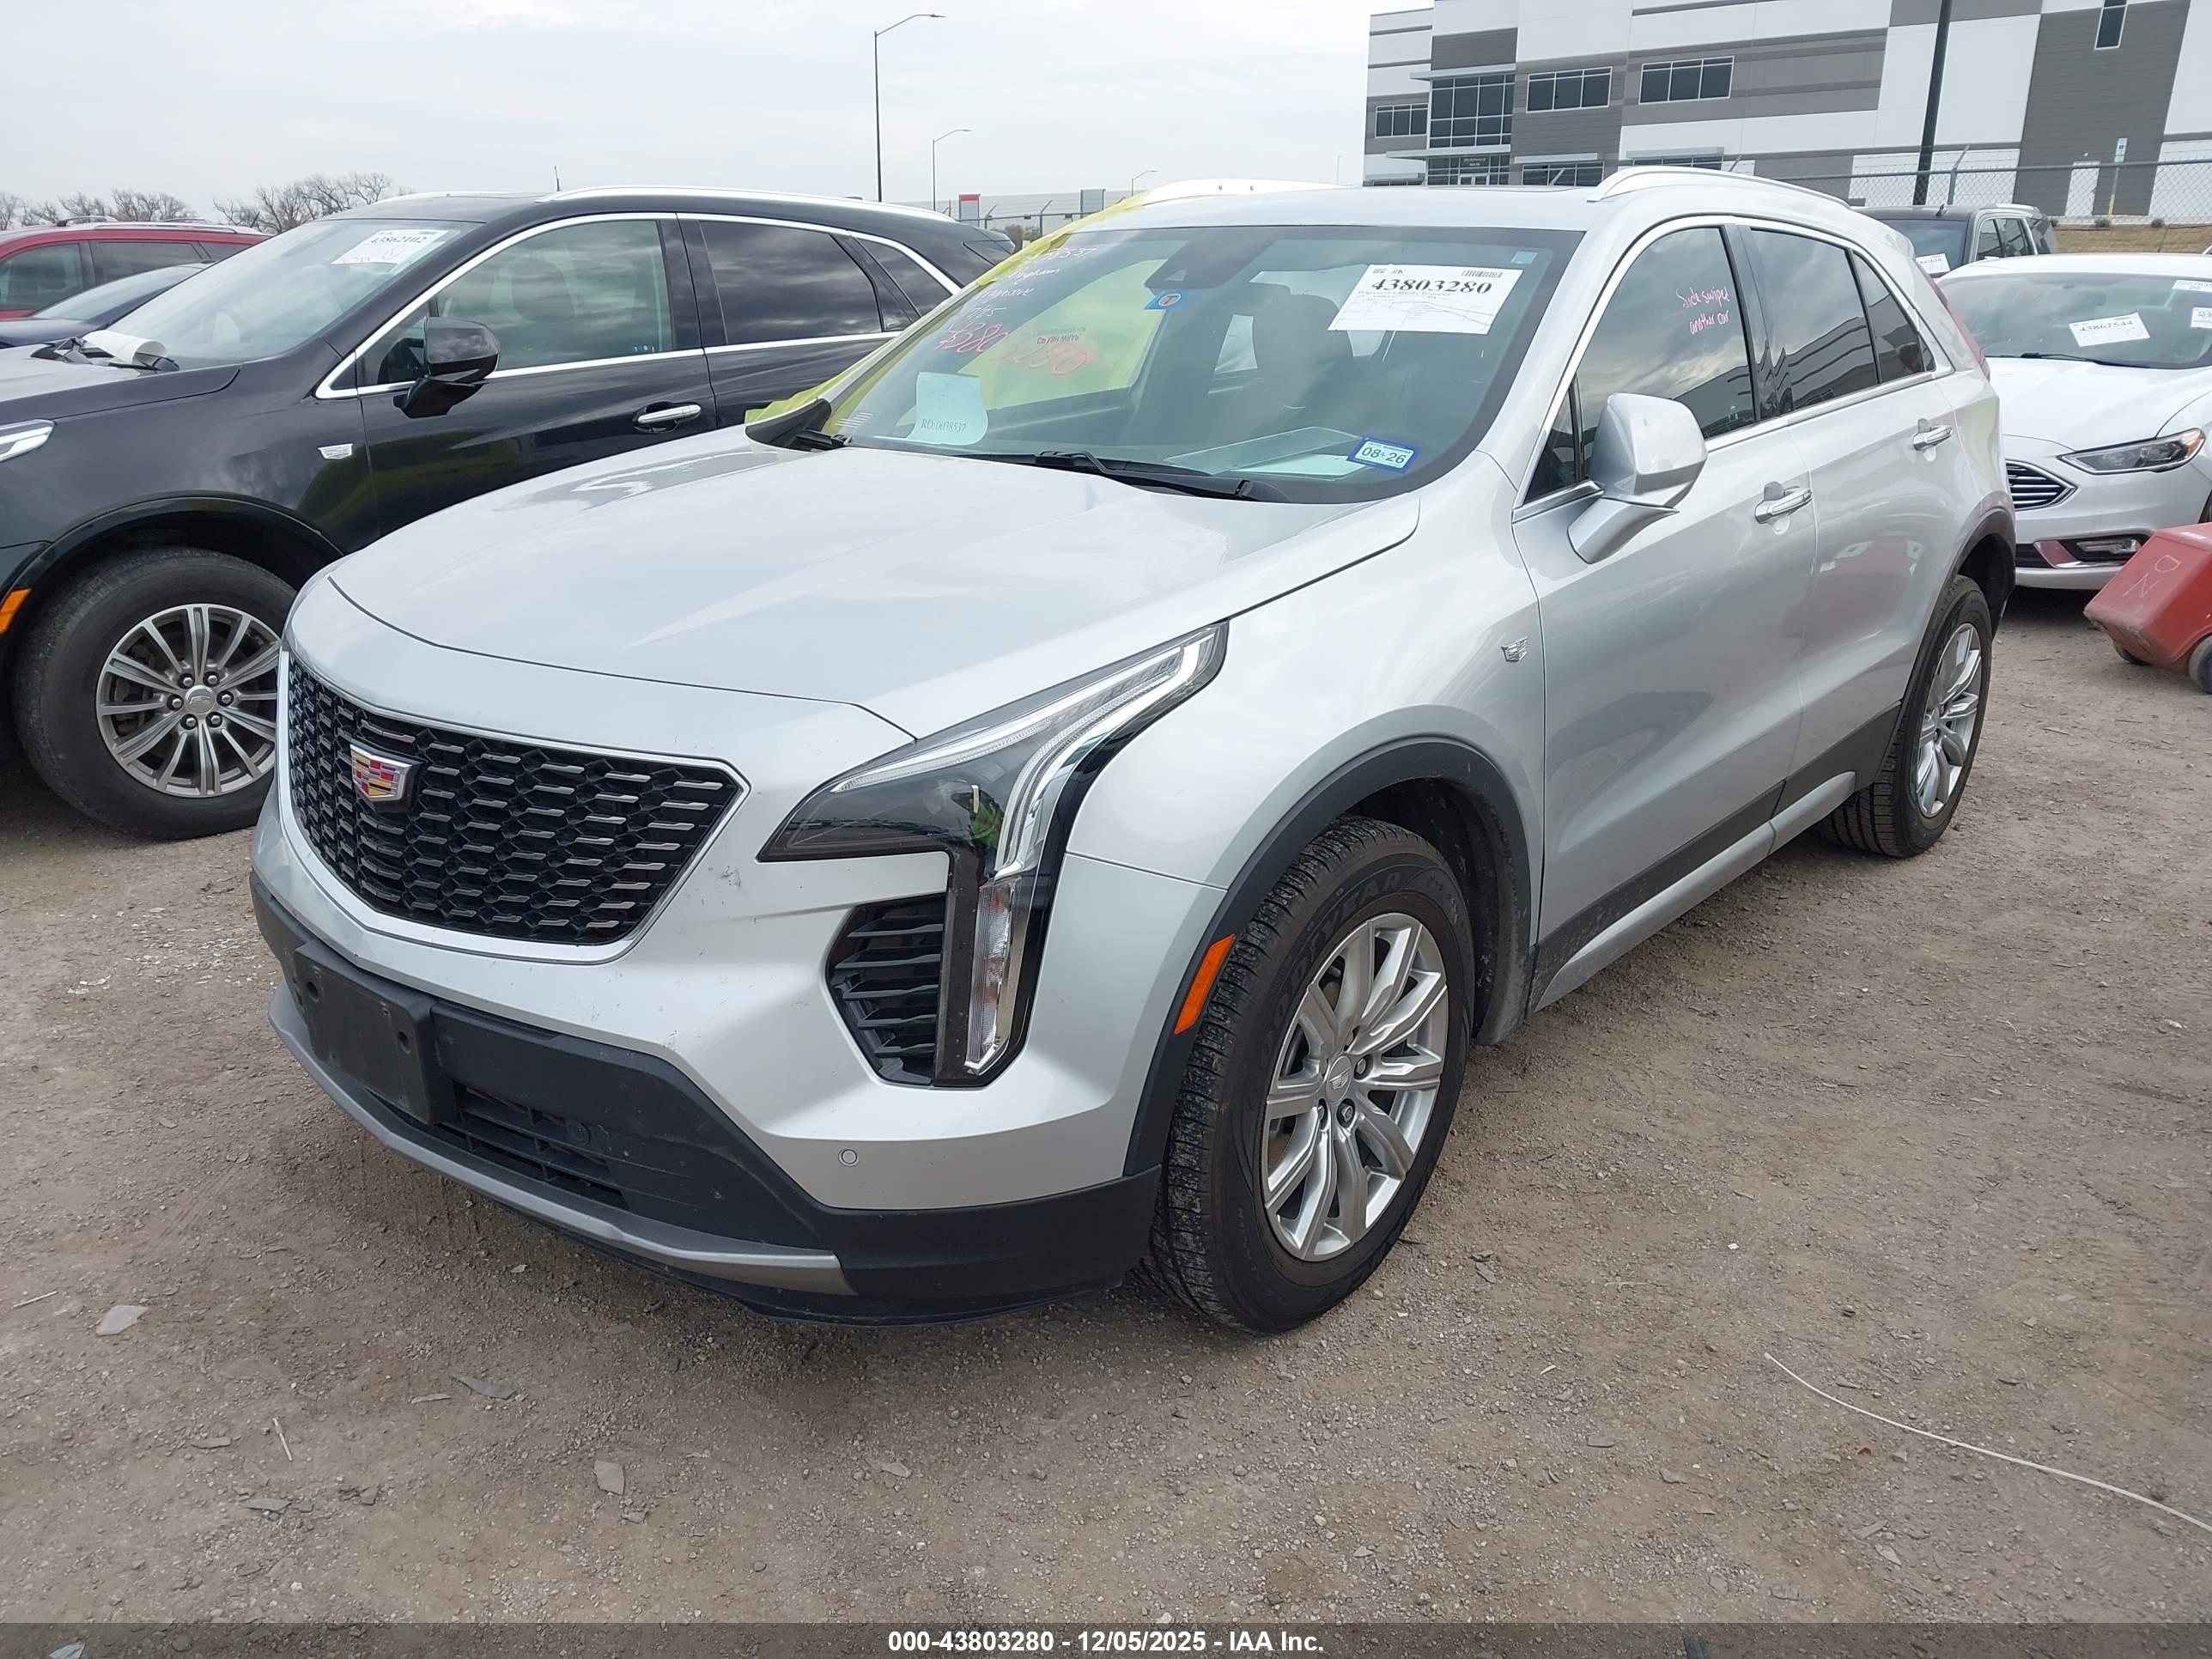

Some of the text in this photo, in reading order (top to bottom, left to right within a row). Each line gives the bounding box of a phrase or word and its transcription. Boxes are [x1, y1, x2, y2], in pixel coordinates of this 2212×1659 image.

[1371, 278, 1492, 294] 43803280
[1361, 447, 1382, 458] 08
[1385, 452, 1407, 464] 26
